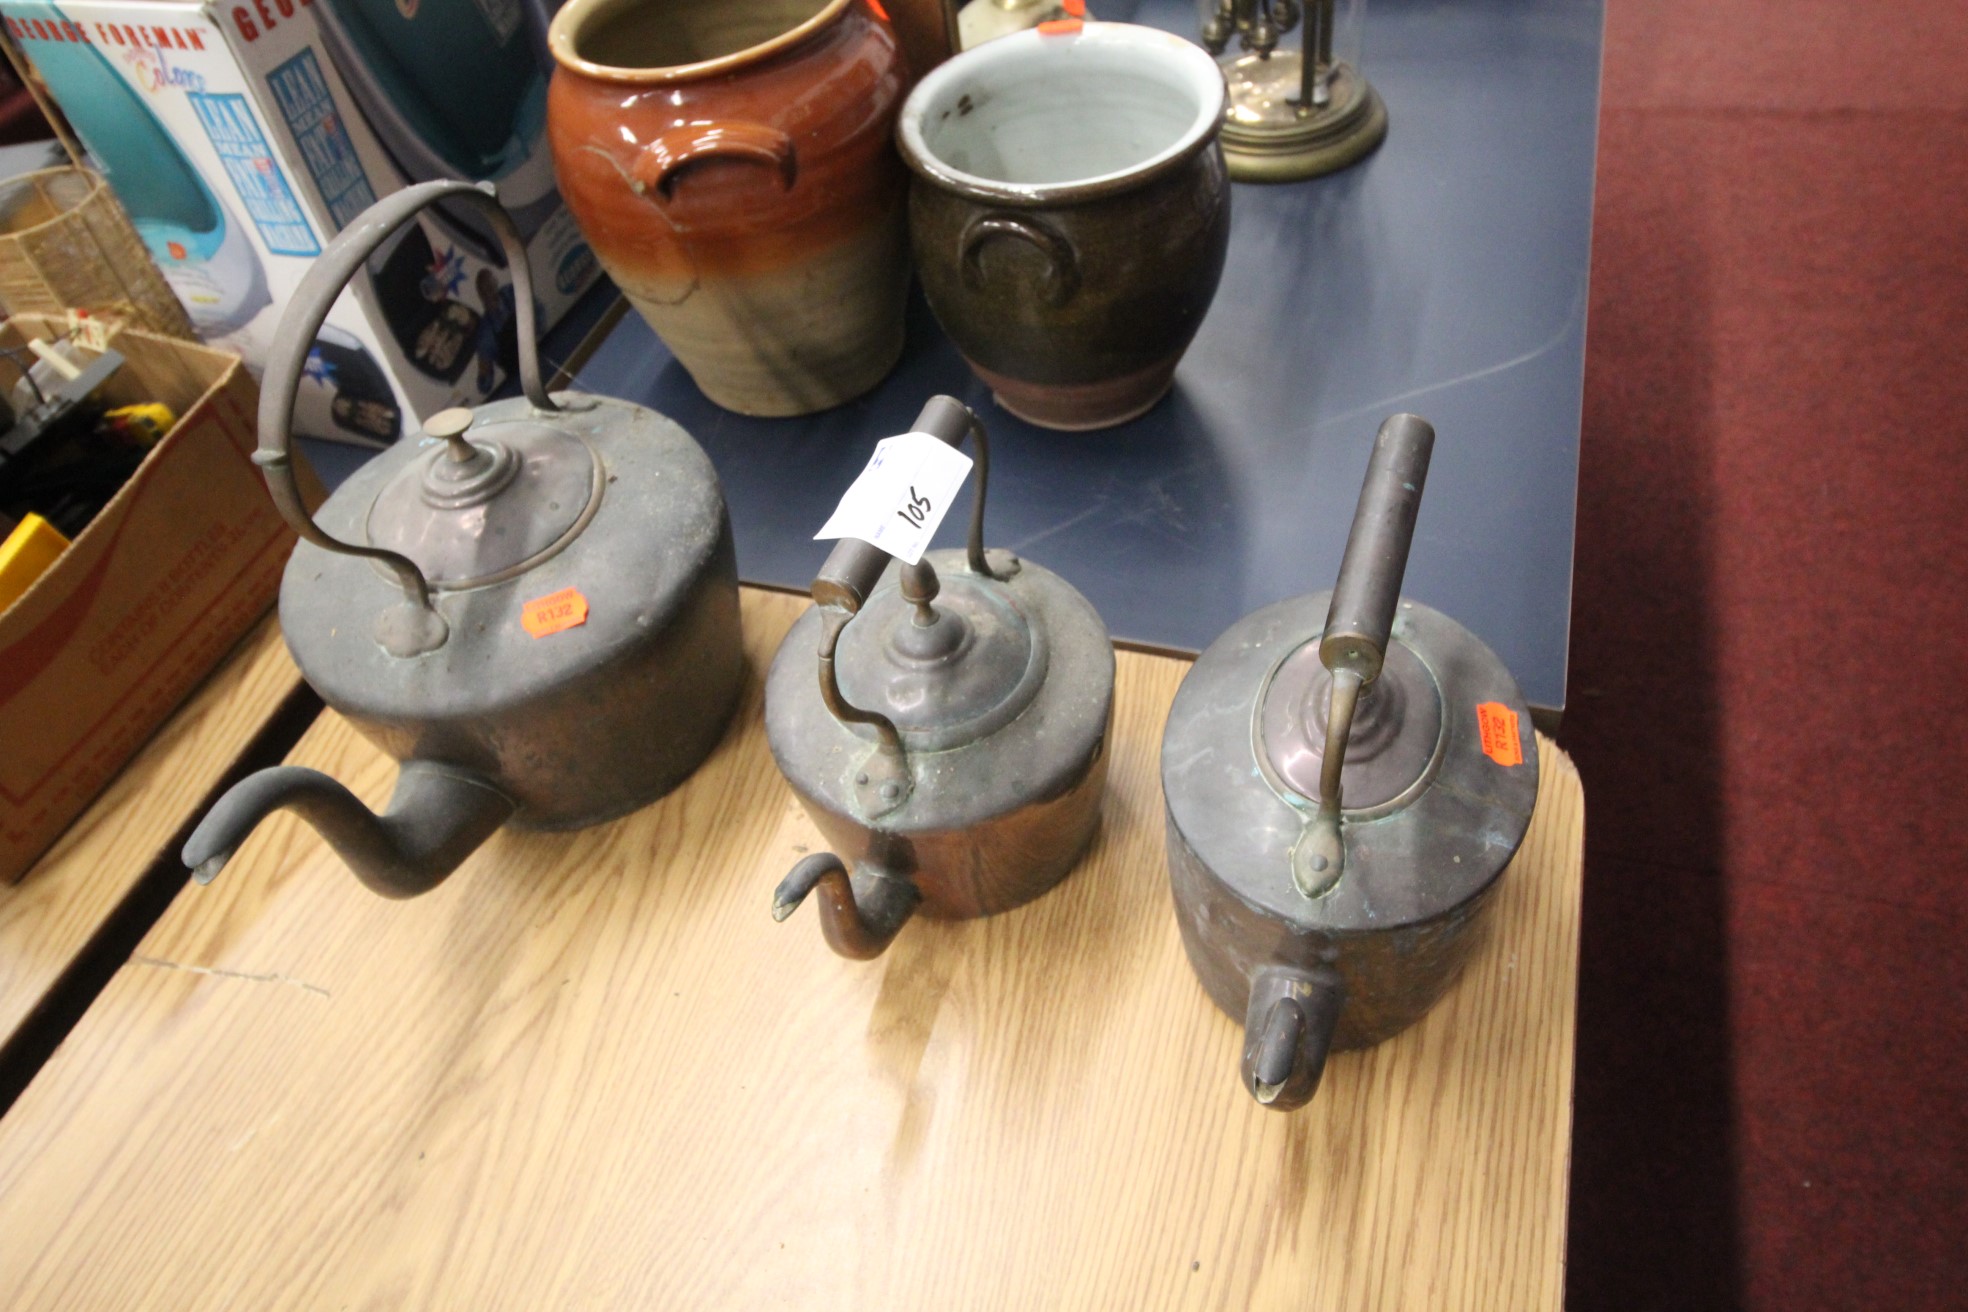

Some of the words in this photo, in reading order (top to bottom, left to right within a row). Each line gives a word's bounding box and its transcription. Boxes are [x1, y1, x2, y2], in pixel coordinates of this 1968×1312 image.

[5, 16, 91, 43] GEORGE
[95, 22, 205, 50] FOREMAN
[232, 0, 313, 42] GEO
[191, 99, 263, 141] LEAN
[897, 486, 931, 529] 105
[537, 604, 573, 624] R132
[1493, 716, 1508, 751] R132
